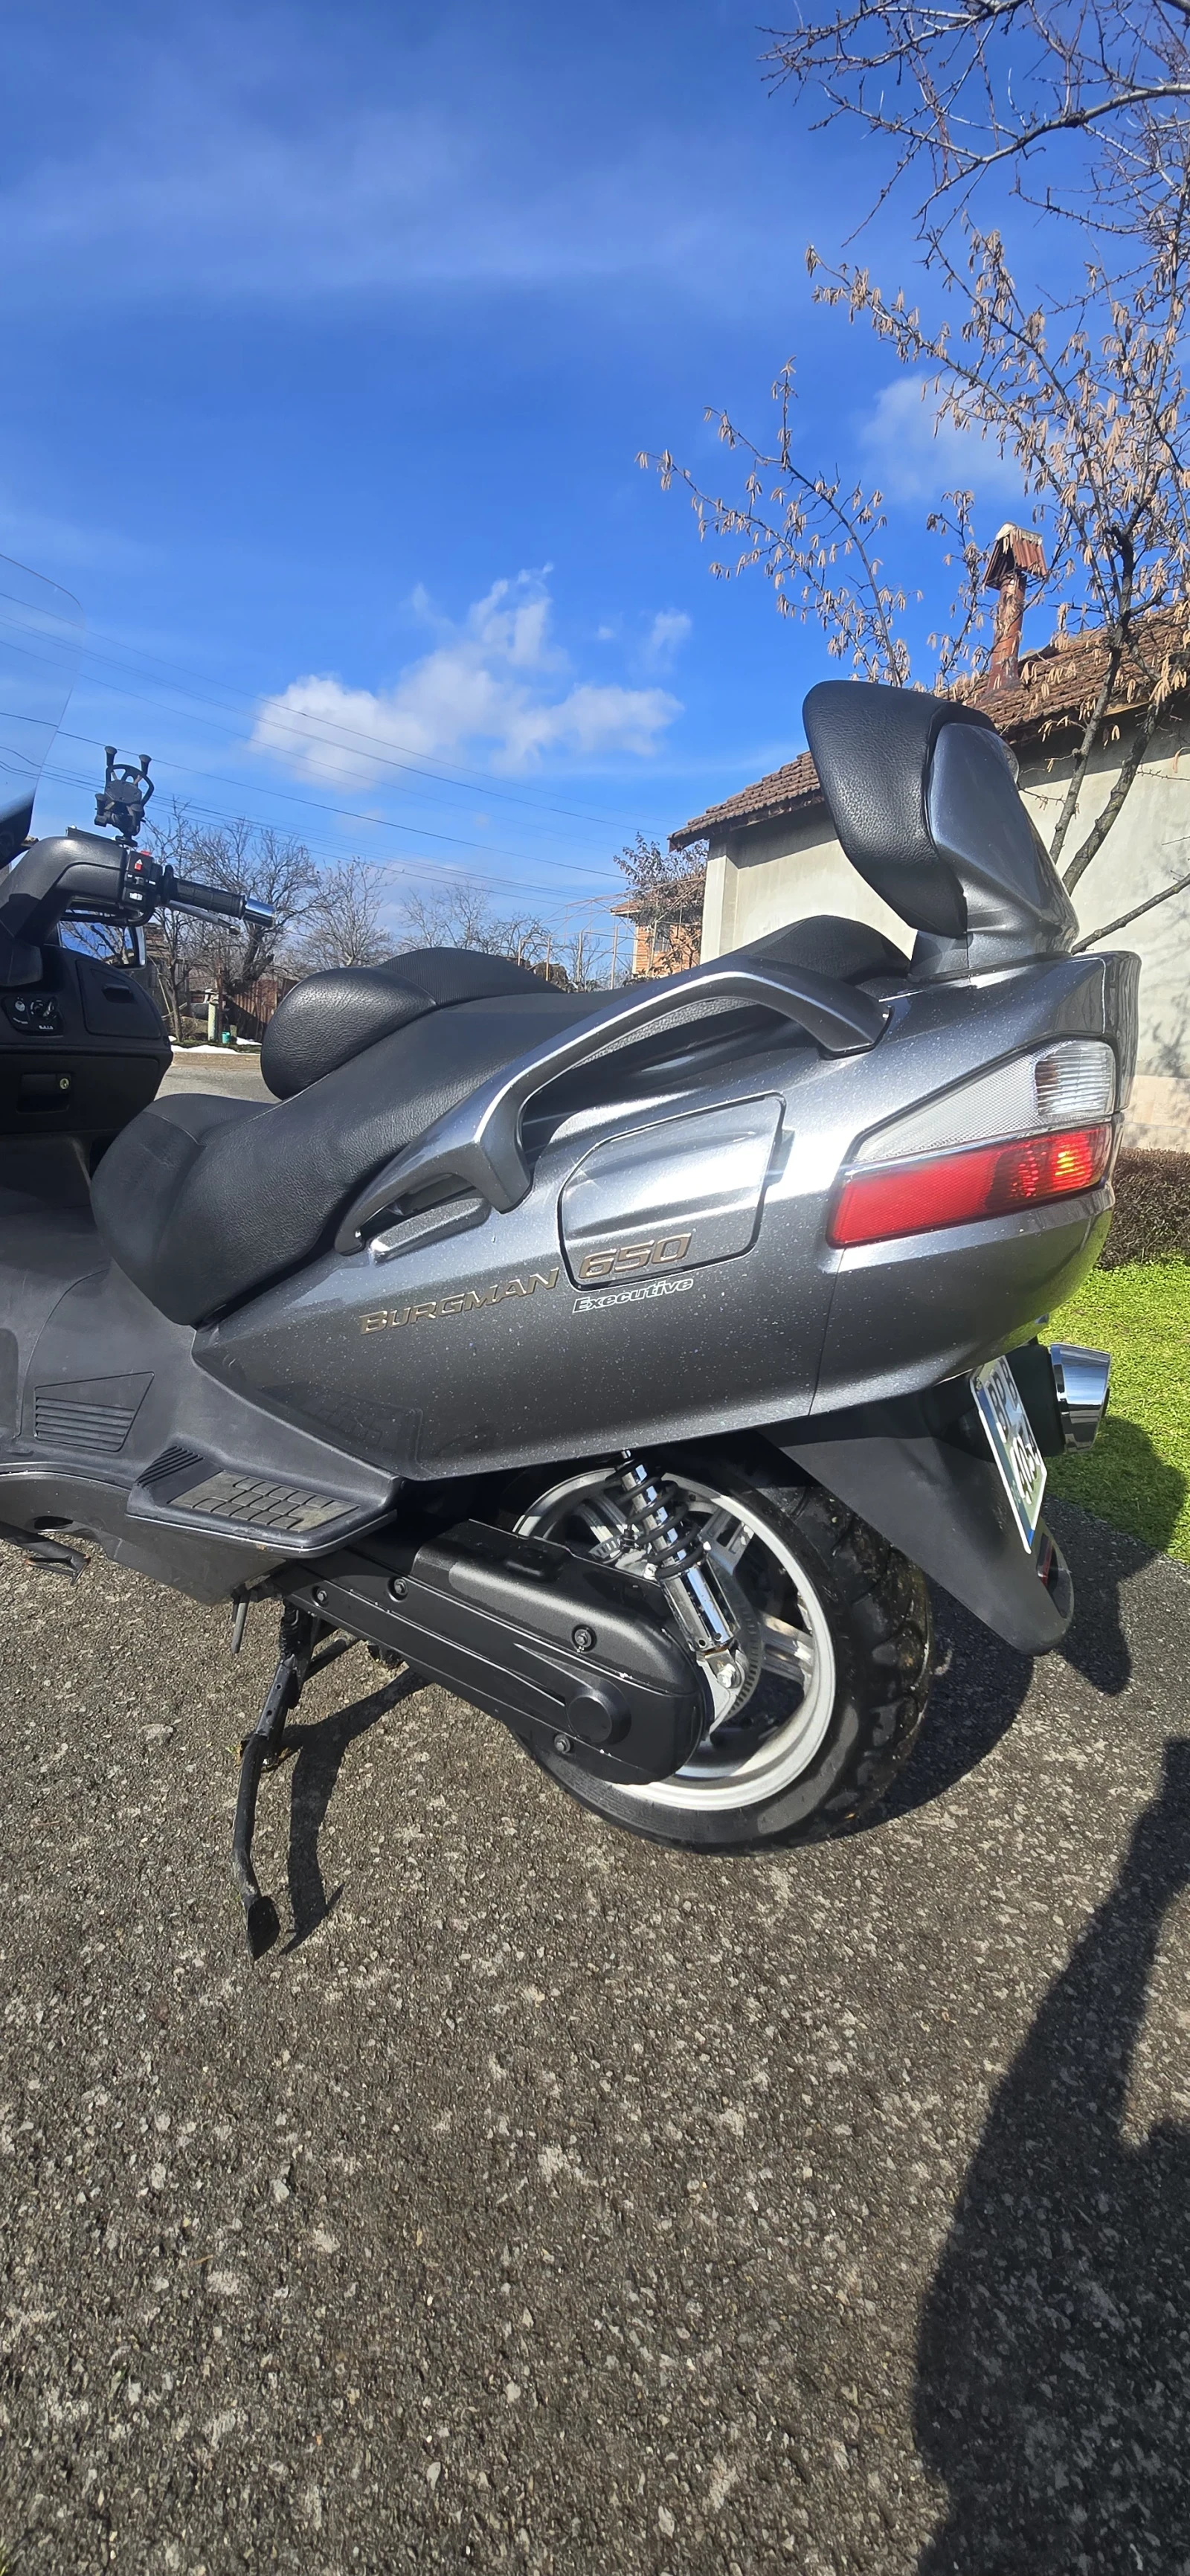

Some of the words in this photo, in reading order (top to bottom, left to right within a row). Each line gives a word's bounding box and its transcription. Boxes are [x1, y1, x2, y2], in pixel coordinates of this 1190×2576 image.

[359, 1267, 560, 1334] BURGMAN
[579, 1233, 692, 1279] 650
[572, 1279, 694, 1314] Executive
